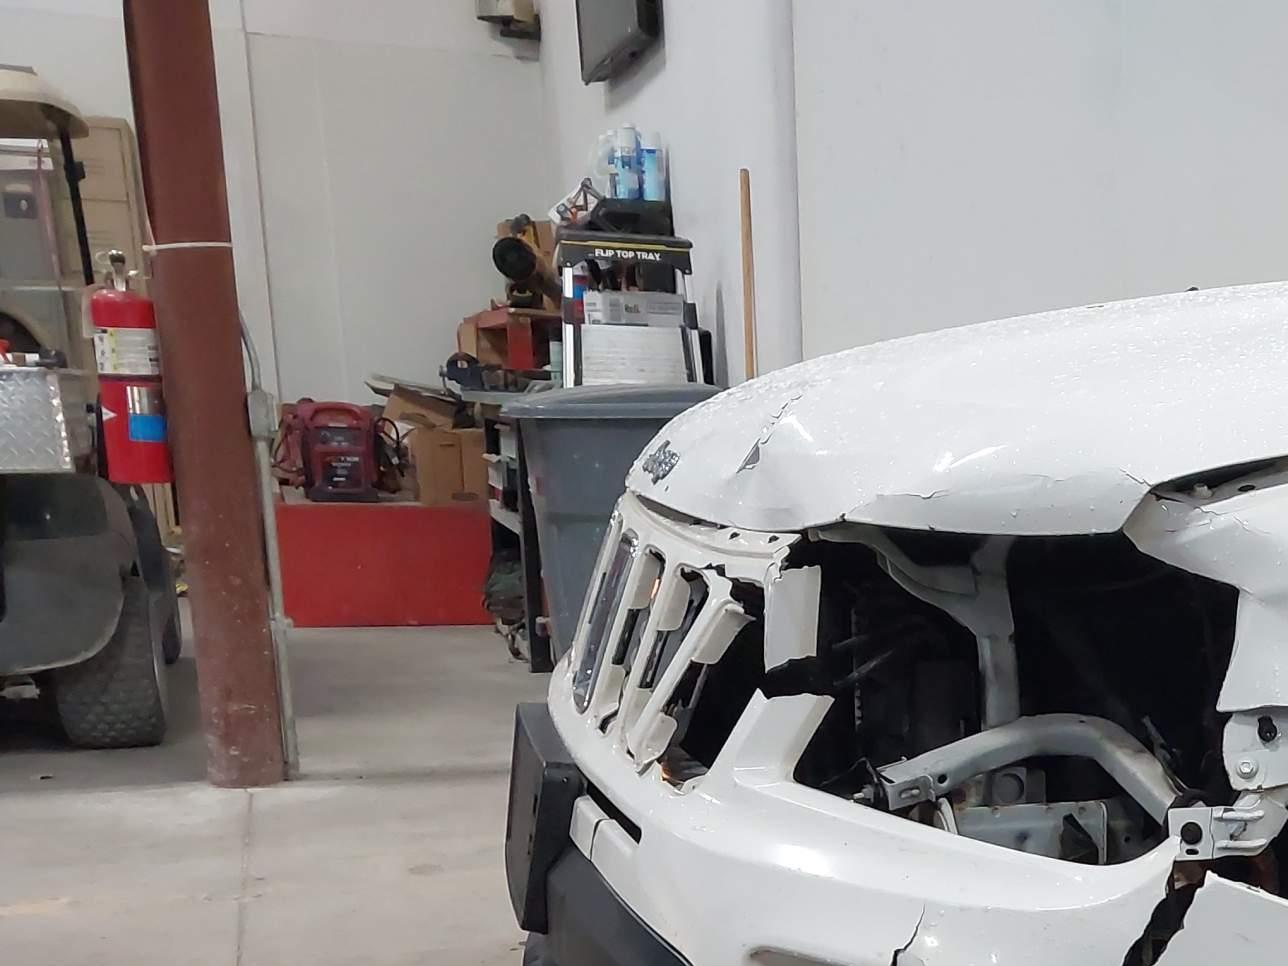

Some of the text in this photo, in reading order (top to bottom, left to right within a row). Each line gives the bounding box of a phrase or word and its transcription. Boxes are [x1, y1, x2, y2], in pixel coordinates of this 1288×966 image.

[594, 248, 661, 261] FLIP TOP TRAY
